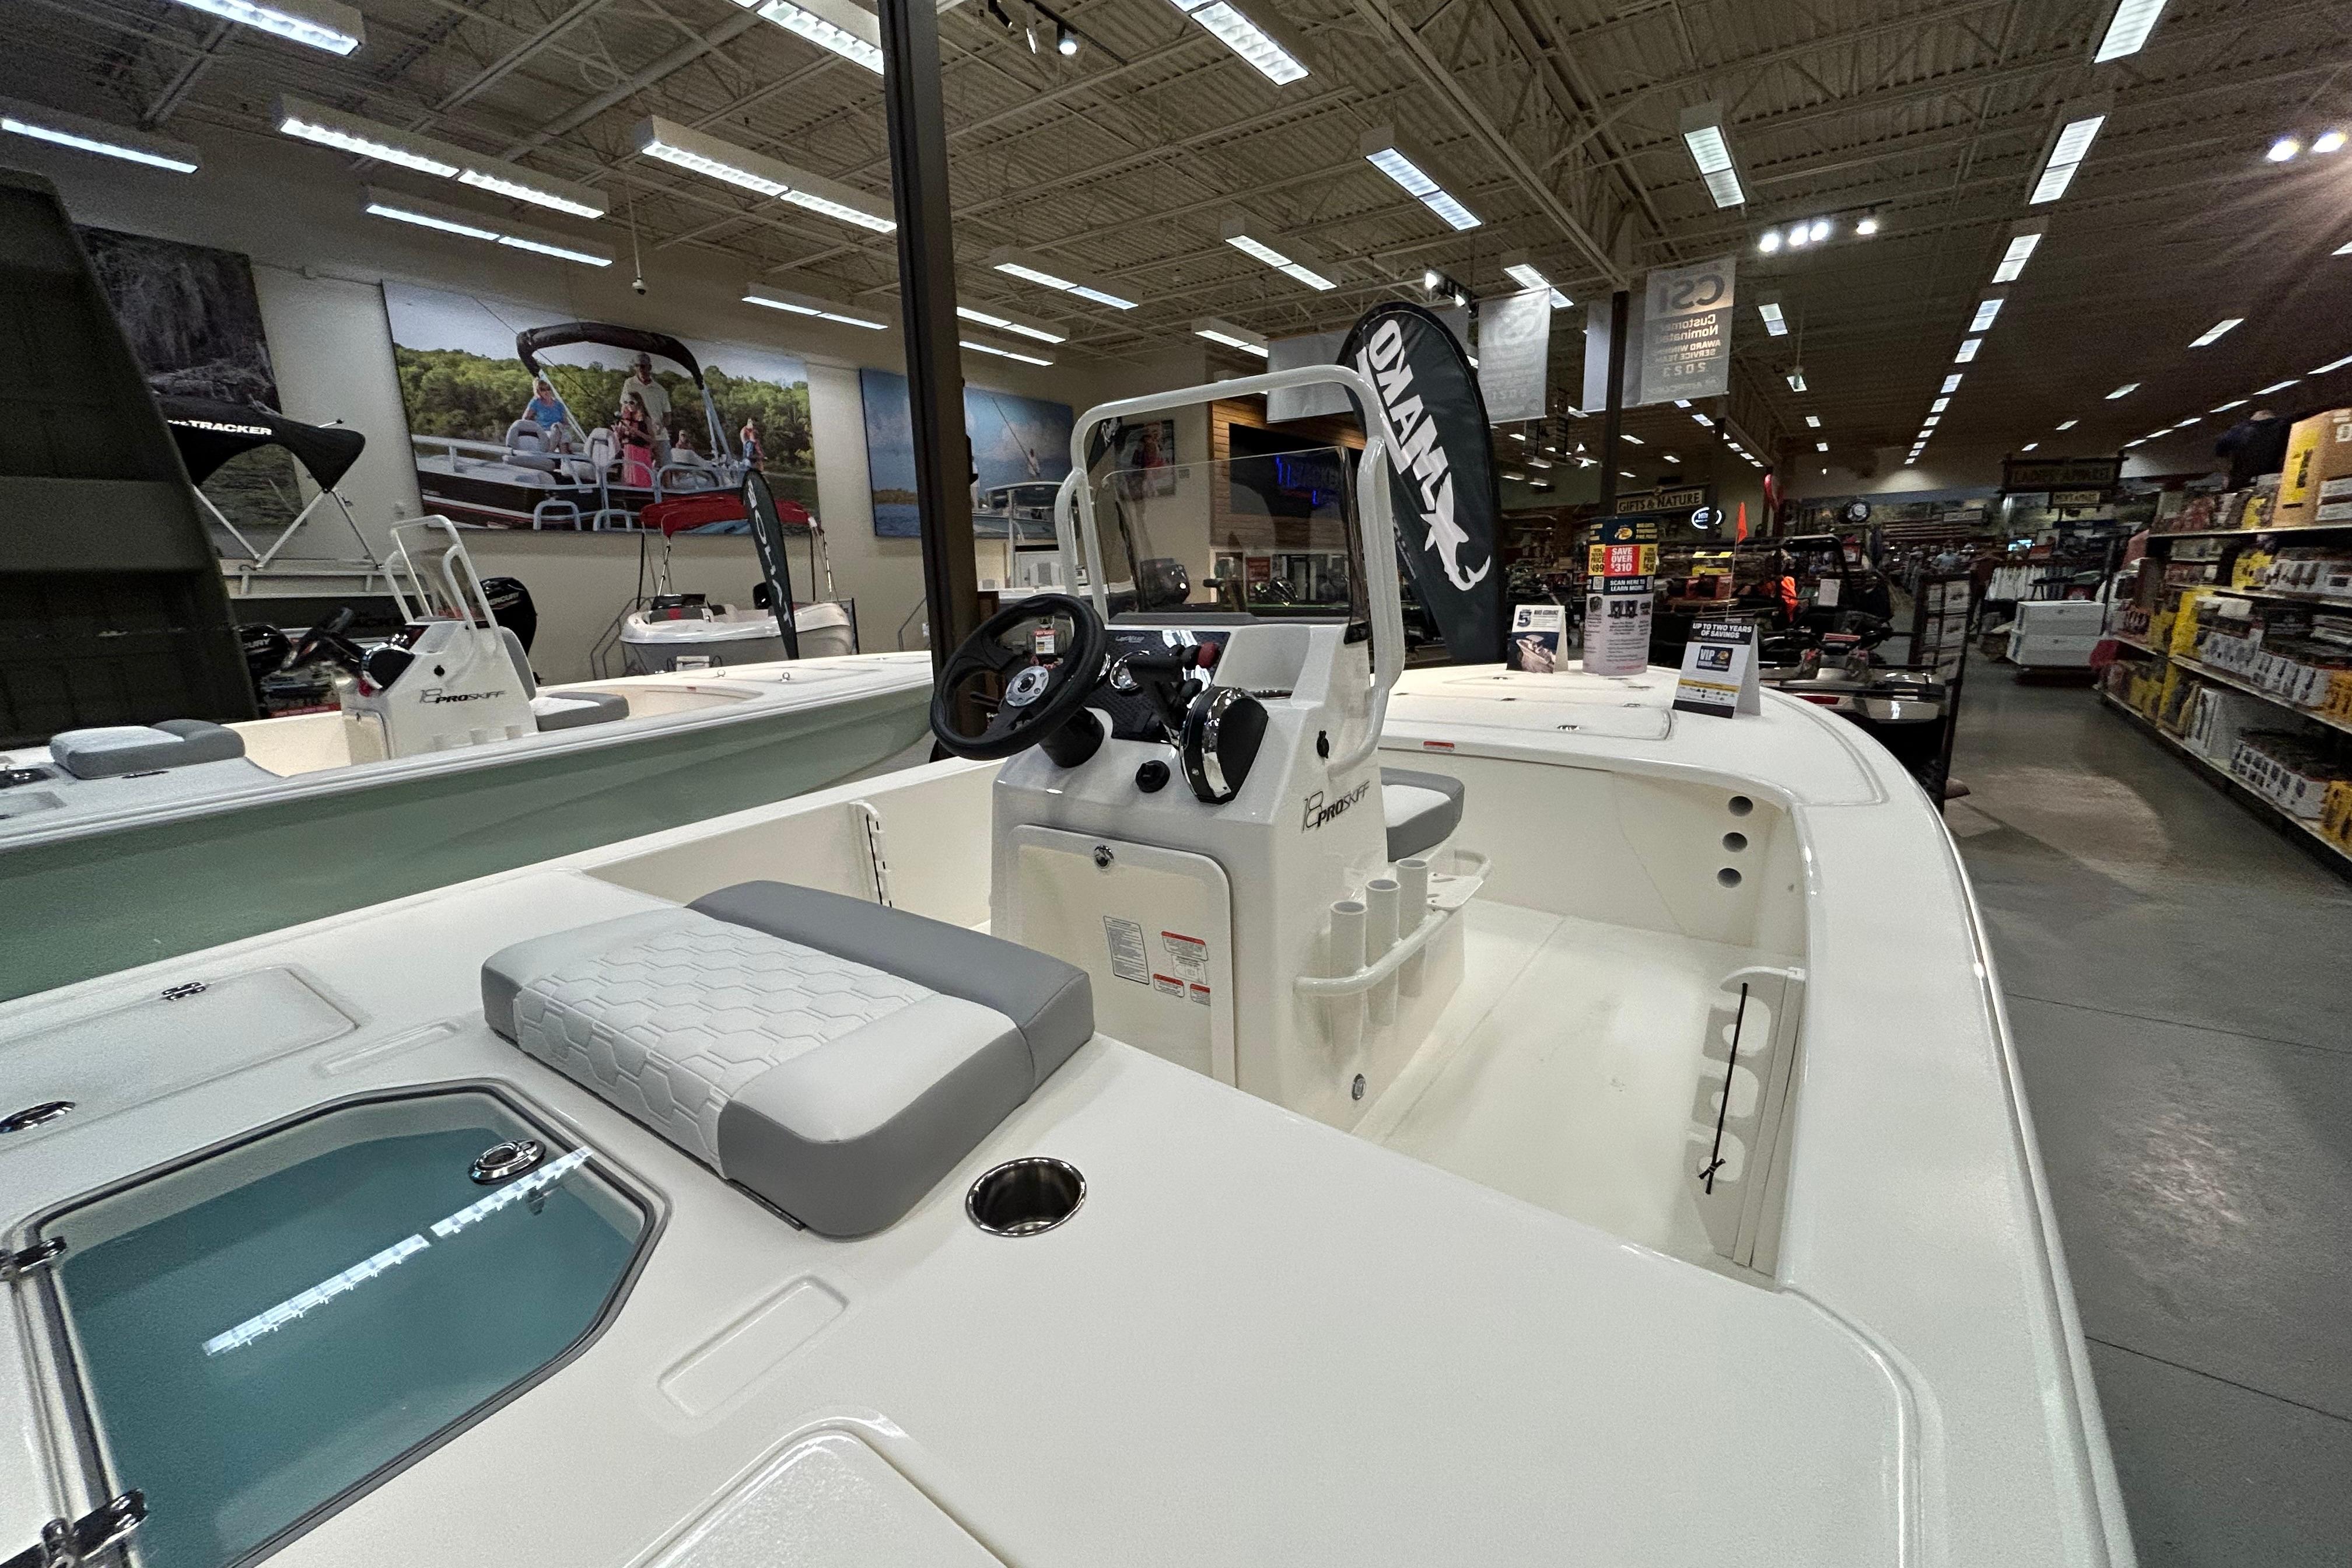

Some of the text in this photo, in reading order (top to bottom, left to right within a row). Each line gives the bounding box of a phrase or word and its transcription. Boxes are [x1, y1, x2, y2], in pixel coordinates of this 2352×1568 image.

[188, 420, 272, 435] TRACKER
[1619, 492, 1700, 512] GIFTS & NATURE
[1612, 547, 1633, 555] SAVE
[1611, 555, 1633, 563] OVER
[1610, 562, 1632, 572] $310
[488, 592, 520, 606] ERCURY
[1700, 649, 1716, 660] VIP
